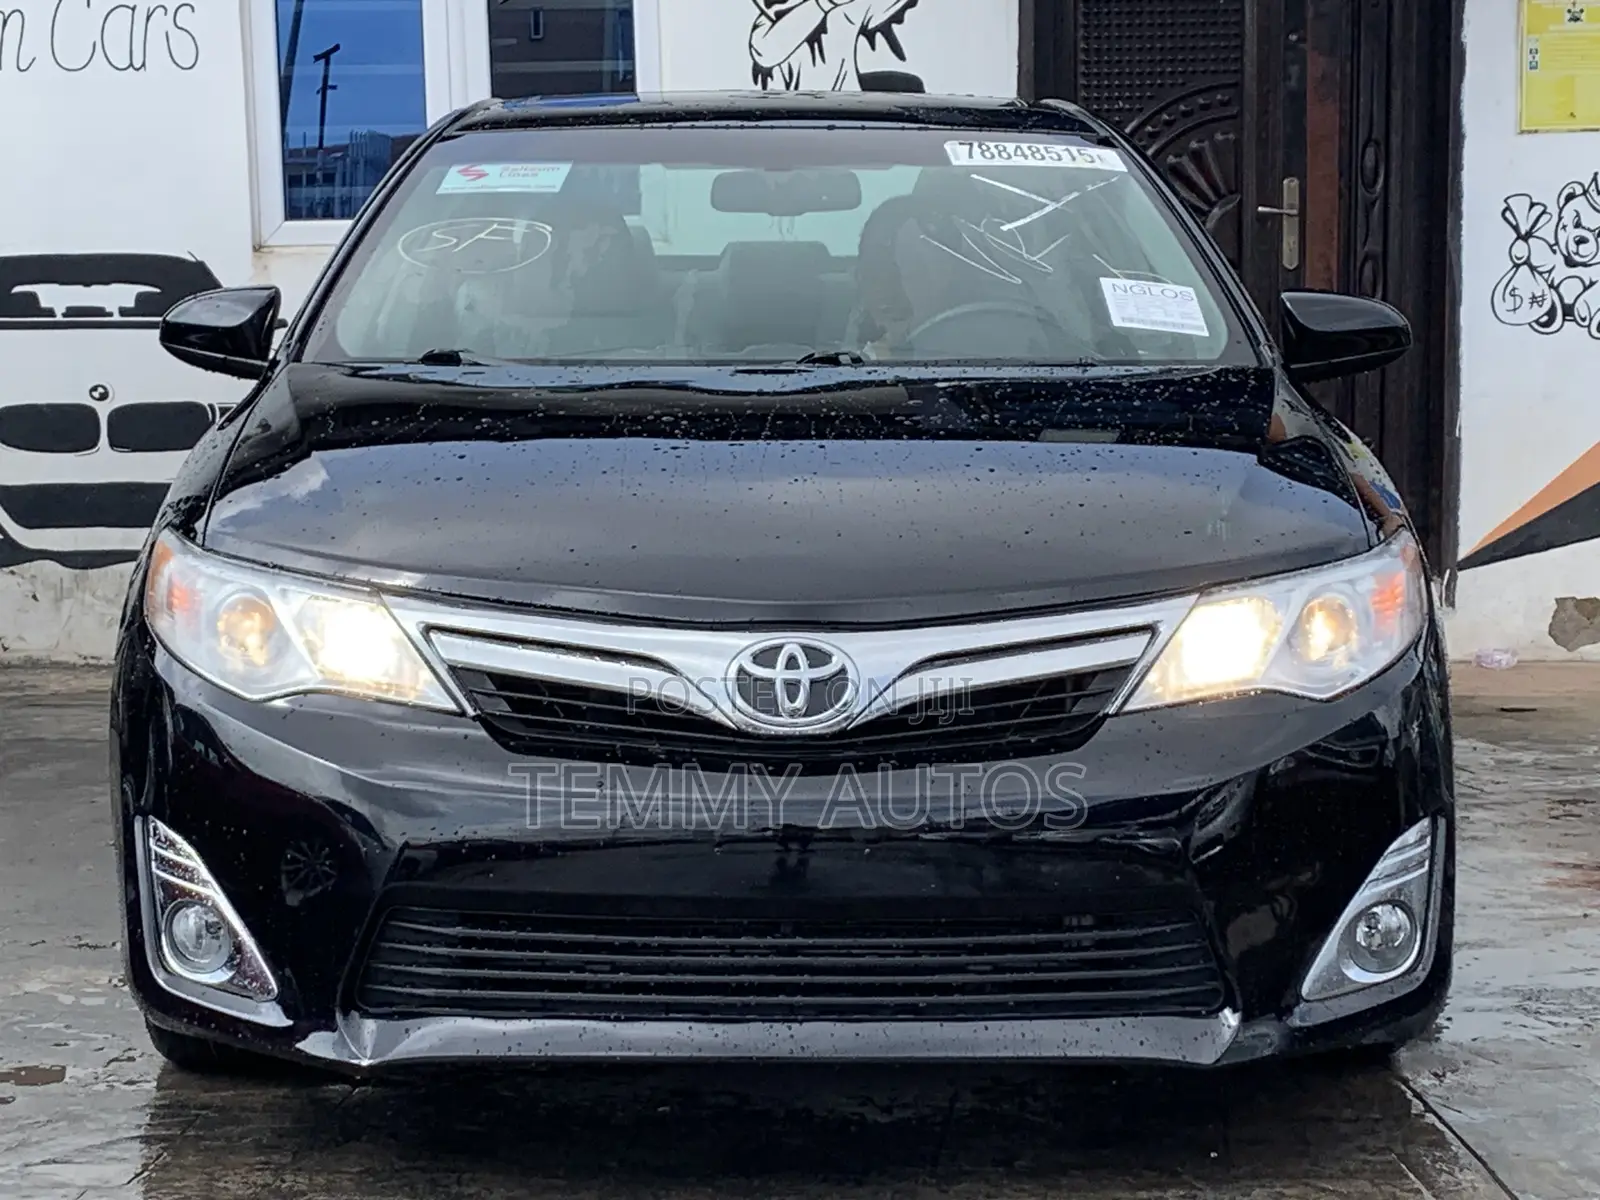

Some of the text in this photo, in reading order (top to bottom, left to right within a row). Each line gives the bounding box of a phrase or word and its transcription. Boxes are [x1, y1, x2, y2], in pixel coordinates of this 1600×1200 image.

[50, 0, 199, 72] Cars
[958, 141, 1108, 164] 78848515
[1111, 282, 1194, 302] NGLOS
